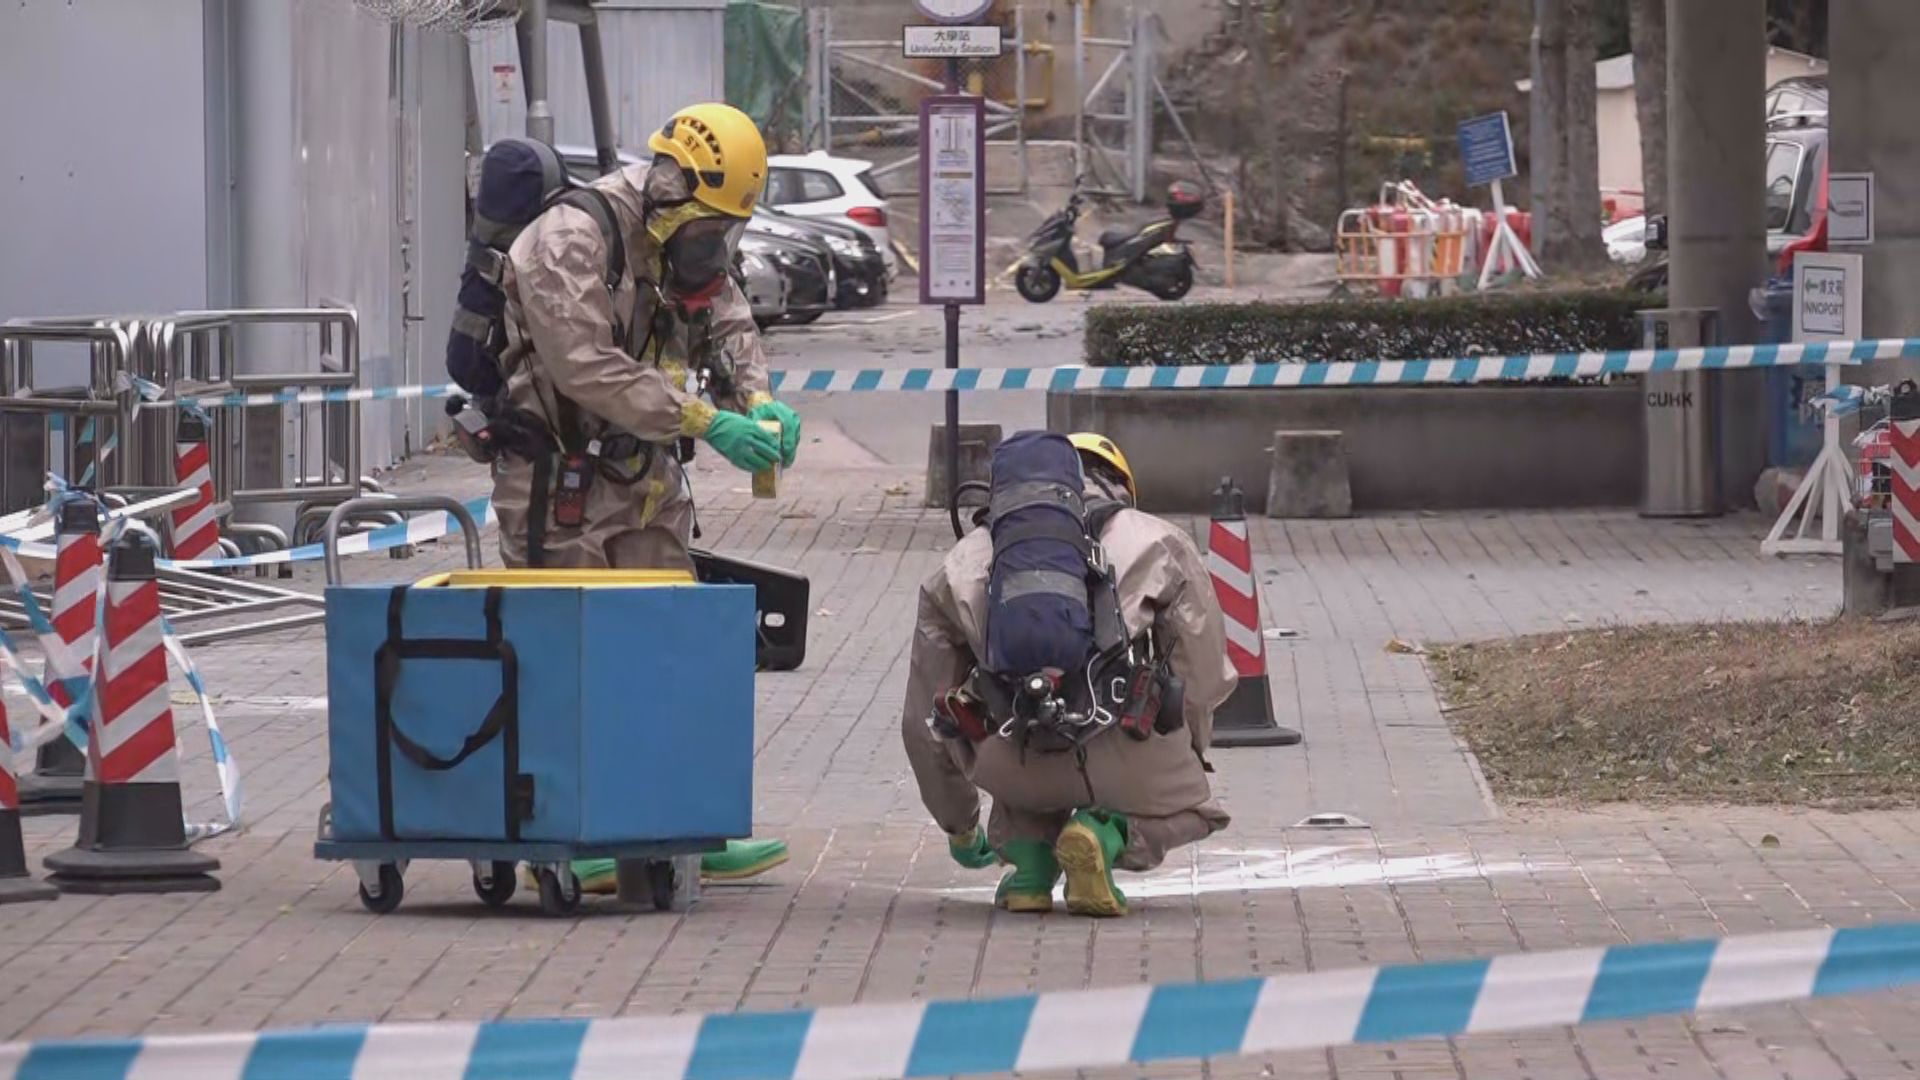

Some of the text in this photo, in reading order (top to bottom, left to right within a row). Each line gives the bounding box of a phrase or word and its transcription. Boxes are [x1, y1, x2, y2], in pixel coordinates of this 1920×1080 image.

[934, 30, 970, 41] 大學站
[911, 42, 995, 55] University Station
[684, 136, 700, 151] ST
[1647, 392, 1693, 408] CUHK
